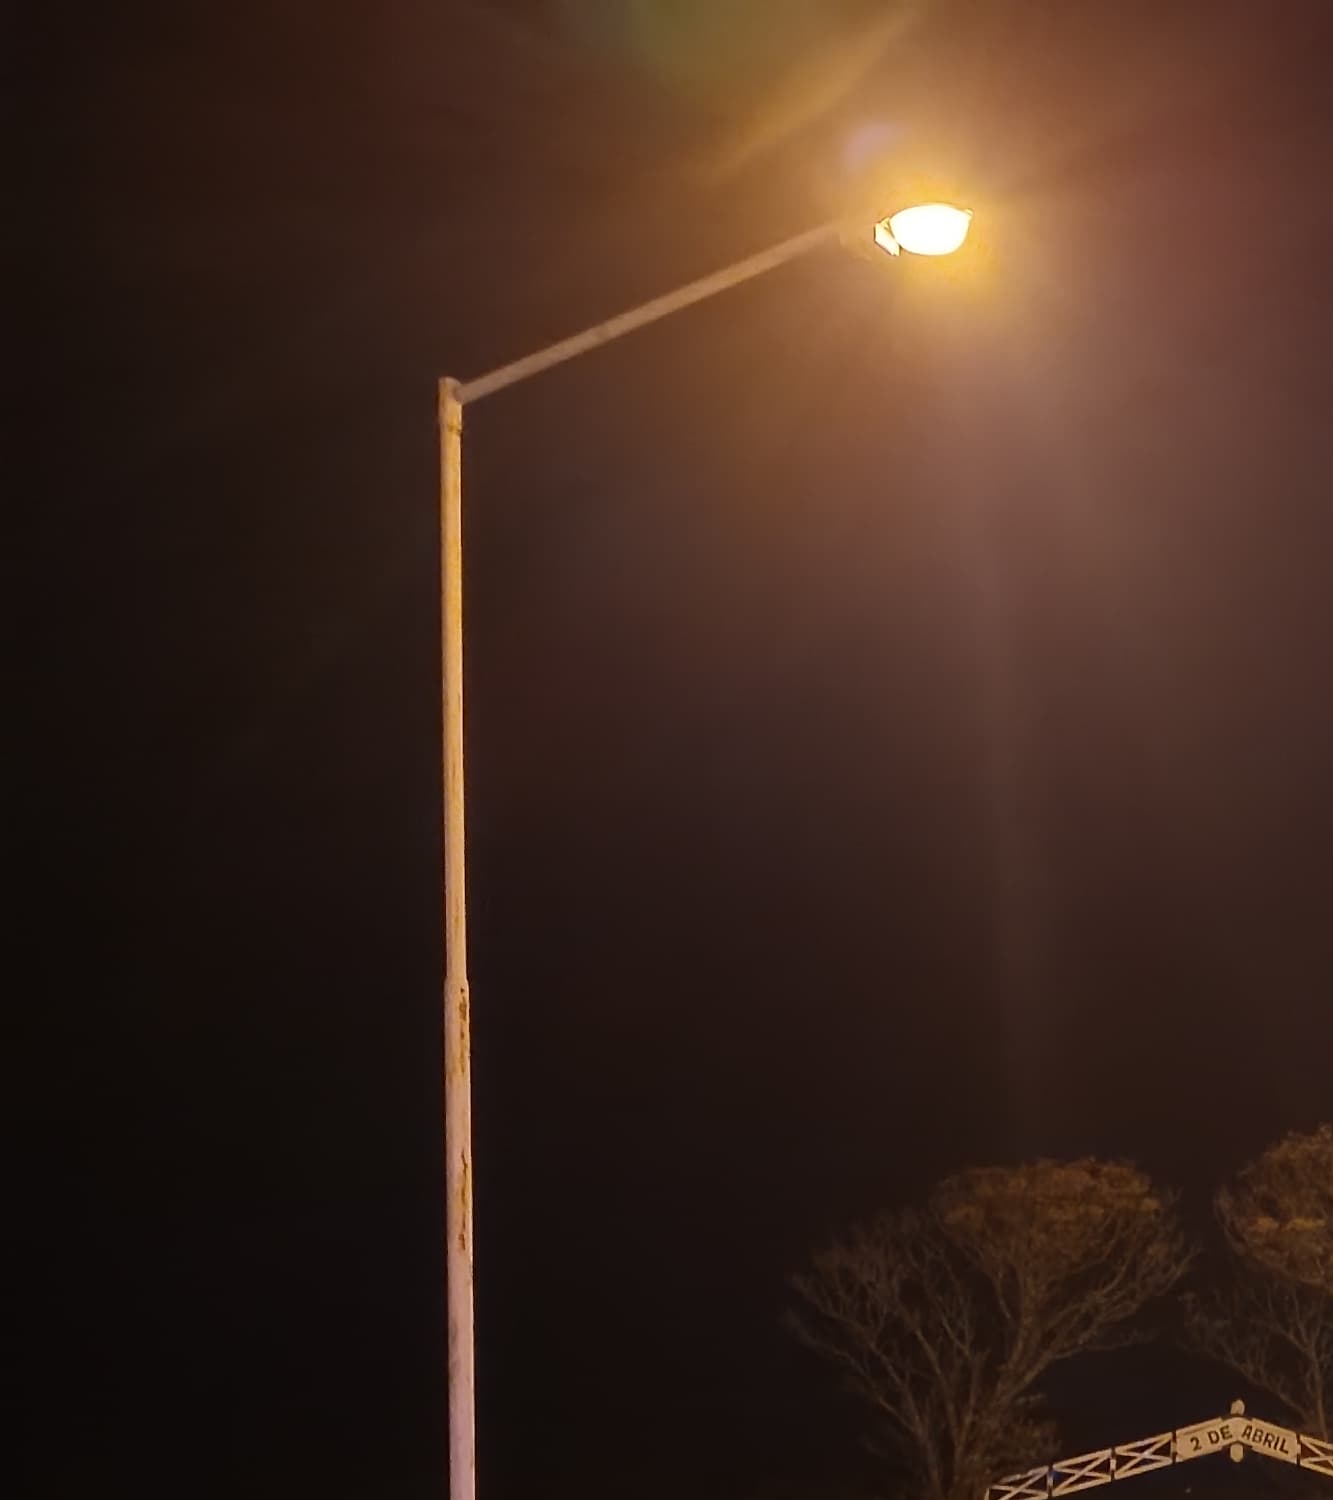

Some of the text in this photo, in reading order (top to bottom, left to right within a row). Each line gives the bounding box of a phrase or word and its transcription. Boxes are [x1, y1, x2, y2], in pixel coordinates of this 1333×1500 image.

[1190, 1425, 1290, 1454] 2 DE ABRIL
